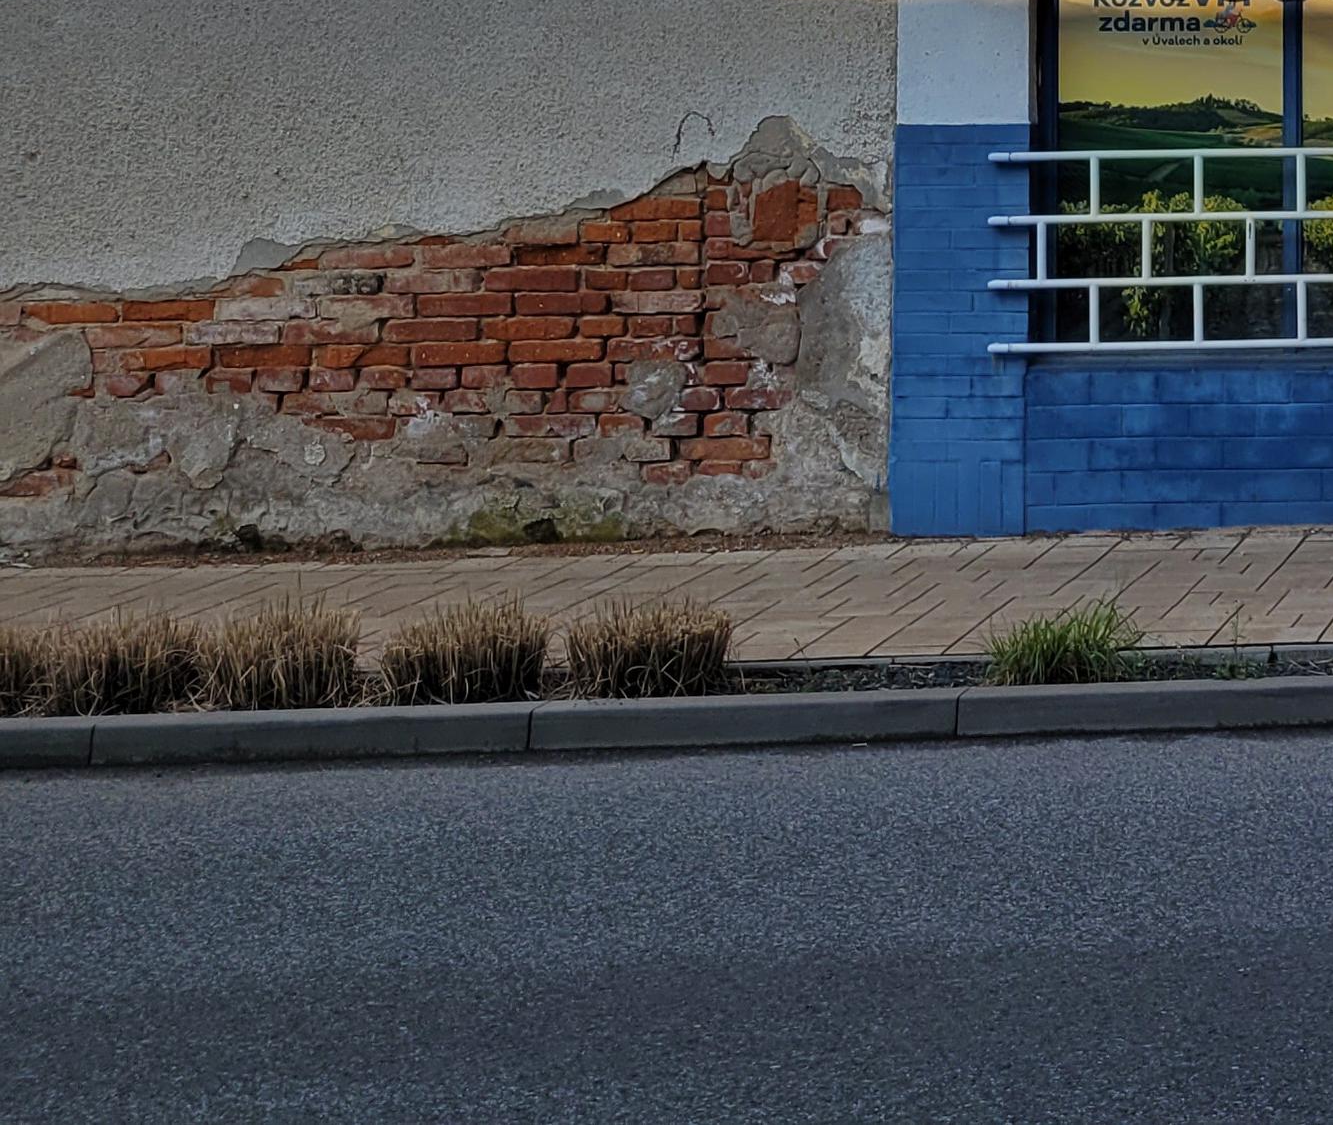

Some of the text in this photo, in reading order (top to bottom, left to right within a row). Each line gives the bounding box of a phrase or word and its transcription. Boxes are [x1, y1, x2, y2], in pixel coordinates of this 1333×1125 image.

[1099, 10, 1201, 32] zdarma
[1152, 33, 1200, 46] Úvalech
[1213, 34, 1243, 46] okolí
